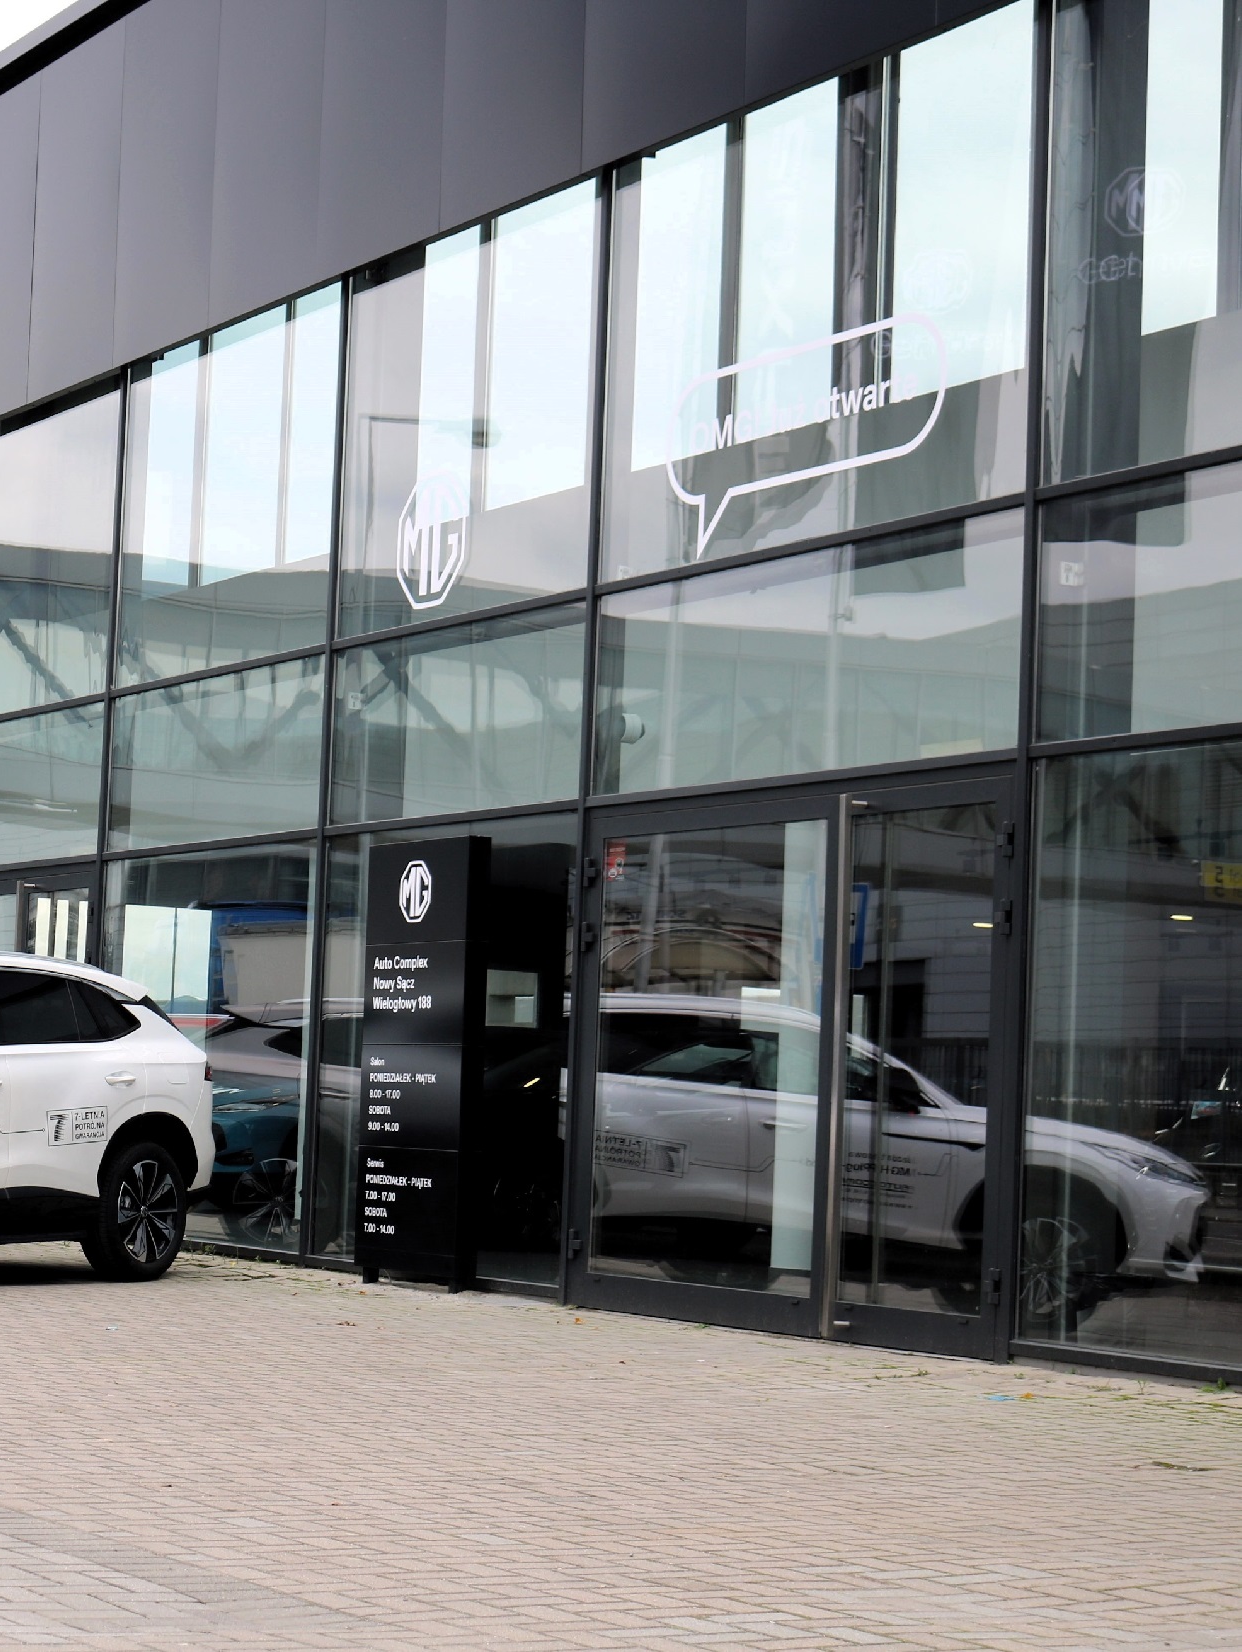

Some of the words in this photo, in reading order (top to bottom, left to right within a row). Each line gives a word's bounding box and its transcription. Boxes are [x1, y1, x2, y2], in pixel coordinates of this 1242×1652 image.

[402, 482, 460, 597] MG
[402, 865, 429, 918] MG
[373, 956, 393, 970] Auto
[394, 955, 428, 971] Complex
[373, 977, 395, 992] Nowy
[396, 976, 415, 991] Sącz
[372, 996, 417, 1012] Wielogłowy
[417, 995, 432, 1009] 188
[370, 1056, 385, 1066] Salon
[369, 1072, 412, 1083] PONIEDZIAŁEK
[415, 1073, 436, 1085] PIĄTEK
[368, 1105, 391, 1115] SOBOTA
[366, 1157, 385, 1168] Serwis
[365, 1173, 408, 1187] PONIEDZIAŁEK
[411, 1177, 433, 1189] PIĄTEK
[365, 1190, 378, 1200] 7.00
[364, 1206, 388, 1218] SOBOTA
[364, 1222, 376, 1233] 7.00
